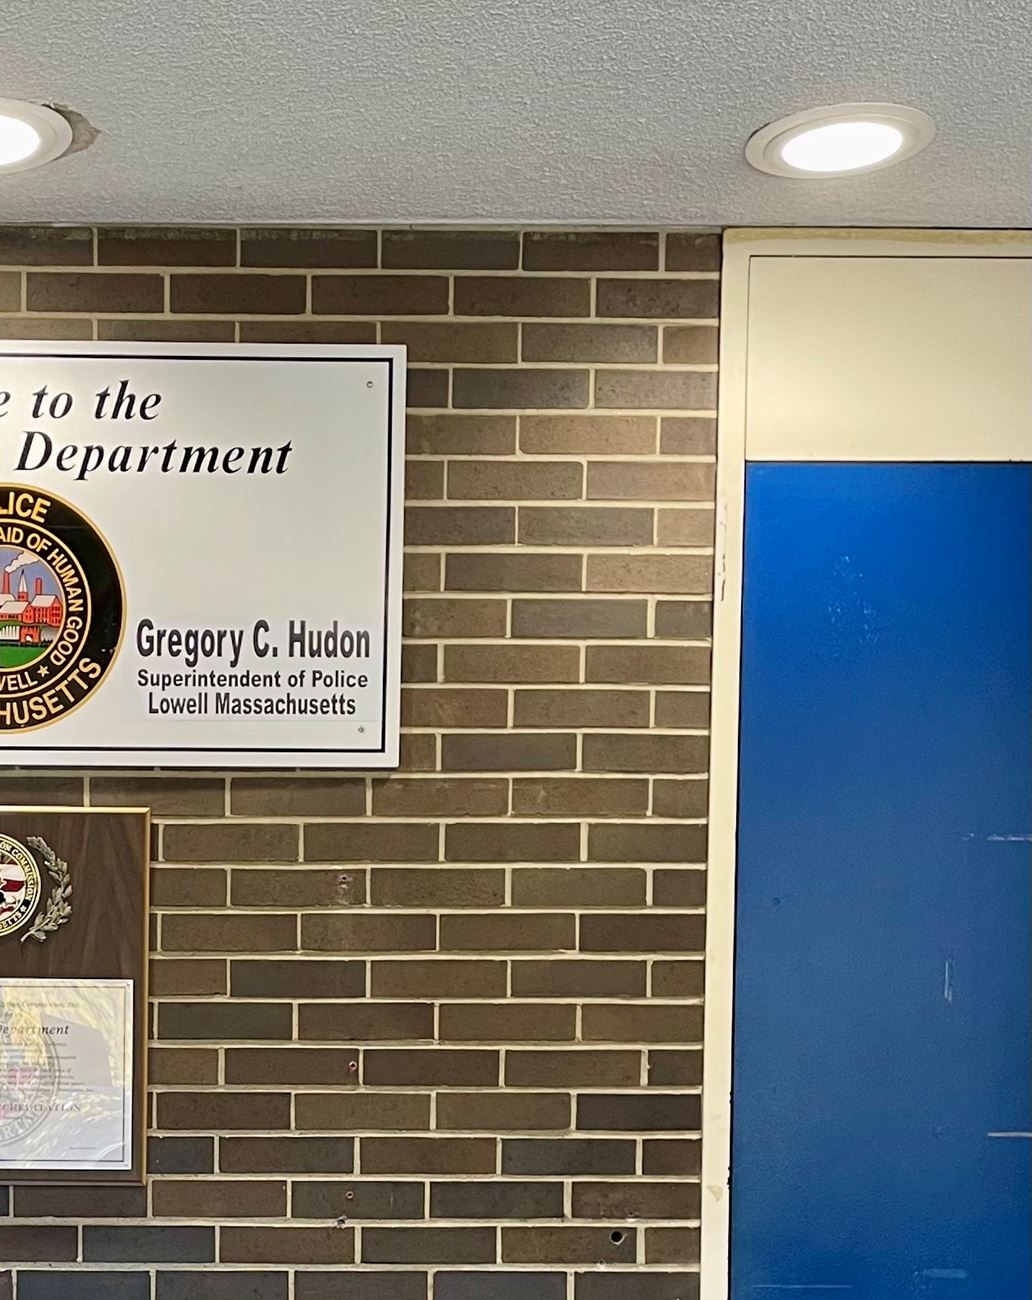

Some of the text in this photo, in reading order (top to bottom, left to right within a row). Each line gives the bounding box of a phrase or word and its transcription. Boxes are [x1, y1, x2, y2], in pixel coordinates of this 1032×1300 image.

[32, 386, 72, 418] to
[95, 380, 161, 420] the
[15, 432, 292, 480] Department
[25, 532, 52, 553] OF
[46, 549, 84, 613] HUMAN
[49, 615, 83, 666] GOOD
[137, 619, 369, 668] Gregory C. Hudon
[137, 669, 367, 691] Superintendent of Police
[148, 692, 355, 714] Lowell Massachusetts
